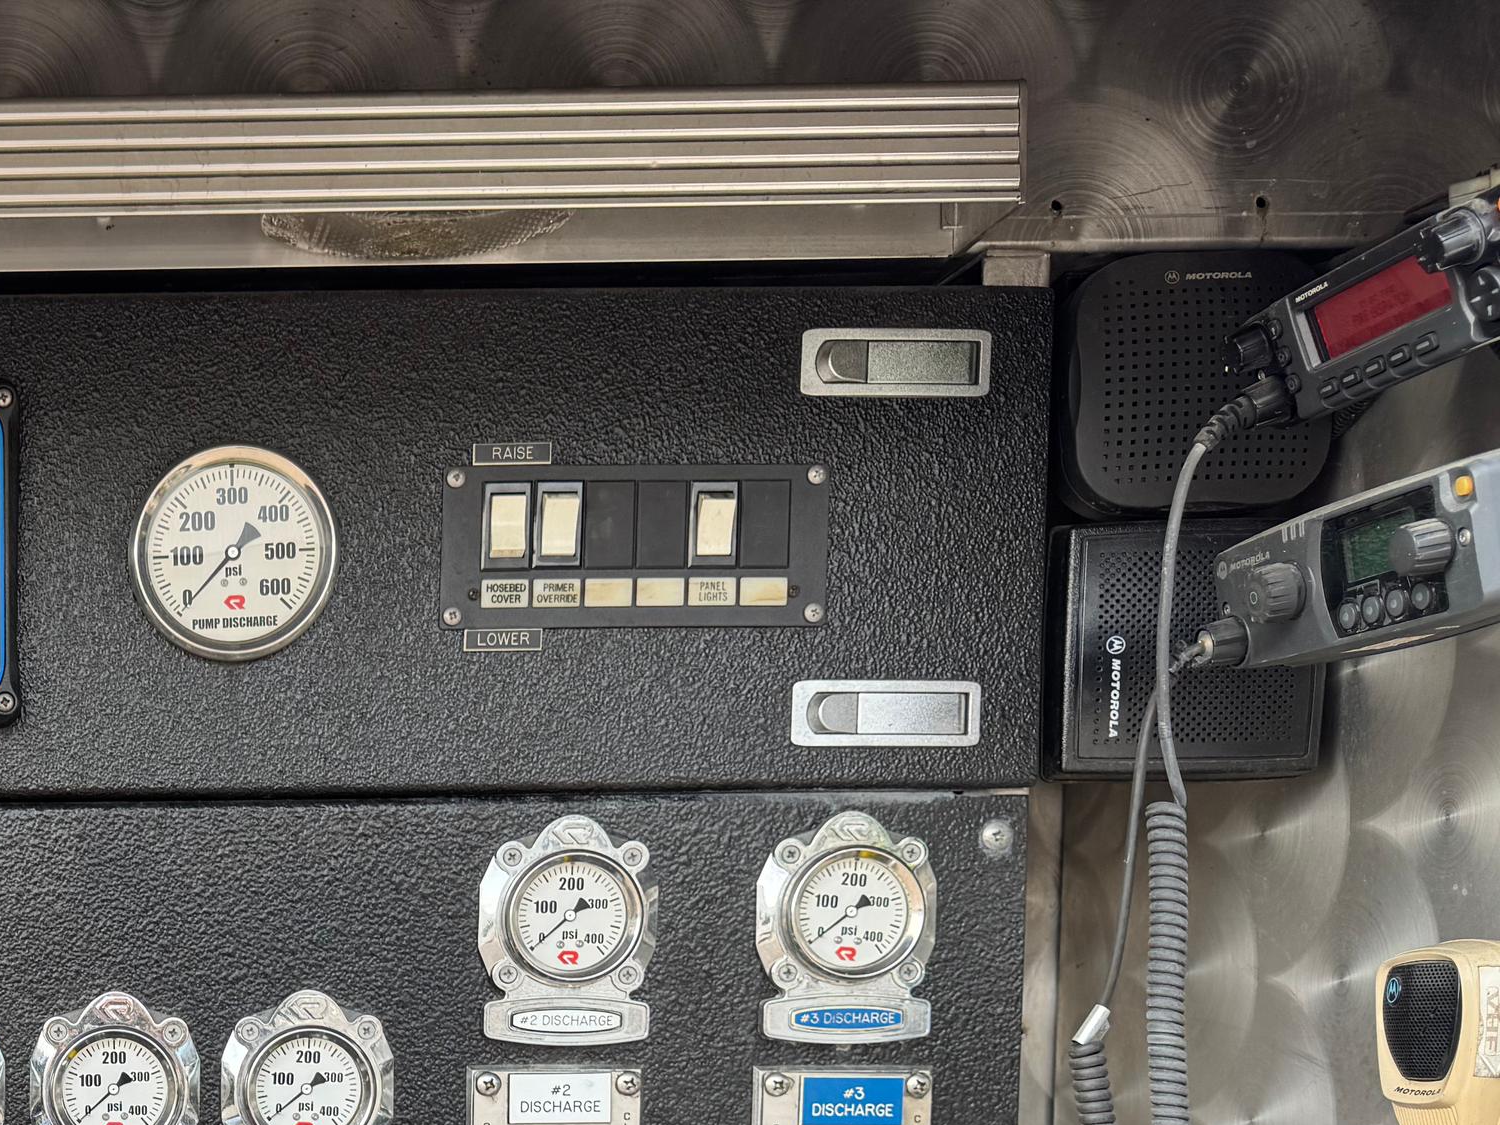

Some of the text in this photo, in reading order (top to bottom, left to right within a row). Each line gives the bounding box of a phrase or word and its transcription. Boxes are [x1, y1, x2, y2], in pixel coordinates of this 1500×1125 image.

[1186, 272, 1253, 280] MOTOROLA
[1295, 282, 1328, 303] MOTOROLA
[492, 447, 534, 459] RAISE
[216, 487, 248, 505] 300
[258, 504, 289, 522] 400
[179, 511, 215, 532] 200
[170, 546, 204, 566] 100
[264, 542, 296, 560] 500
[1229, 552, 1270, 569] MOTOROLA
[260, 578, 290, 595] 600
[486, 583, 526, 593] HOSEBED
[543, 583, 574, 592] PRIMER
[700, 582, 726, 591] PANEL
[491, 594, 521, 604] COVER
[537, 594, 578, 604] OVERRIDE
[699, 591, 728, 601] LIGHTS
[192, 615, 278, 630] PUMP DISCHARGE
[477, 633, 530, 646] LOWER
[1108, 659, 1122, 738] MOTOROLA
[559, 878, 584, 891] 200
[841, 873, 866, 887] 200
[520, 1016, 612, 1025] #2 DISCHARGE
[801, 1013, 895, 1024] #3 DISCHARGE
[102, 1052, 126, 1064] 200
[296, 1051, 320, 1063] 200
[551, 1085, 570, 1096] #2
[844, 1087, 864, 1099] #3
[520, 1101, 601, 1113] DISCHARGE
[811, 1104, 893, 1117] DISCHARGE
